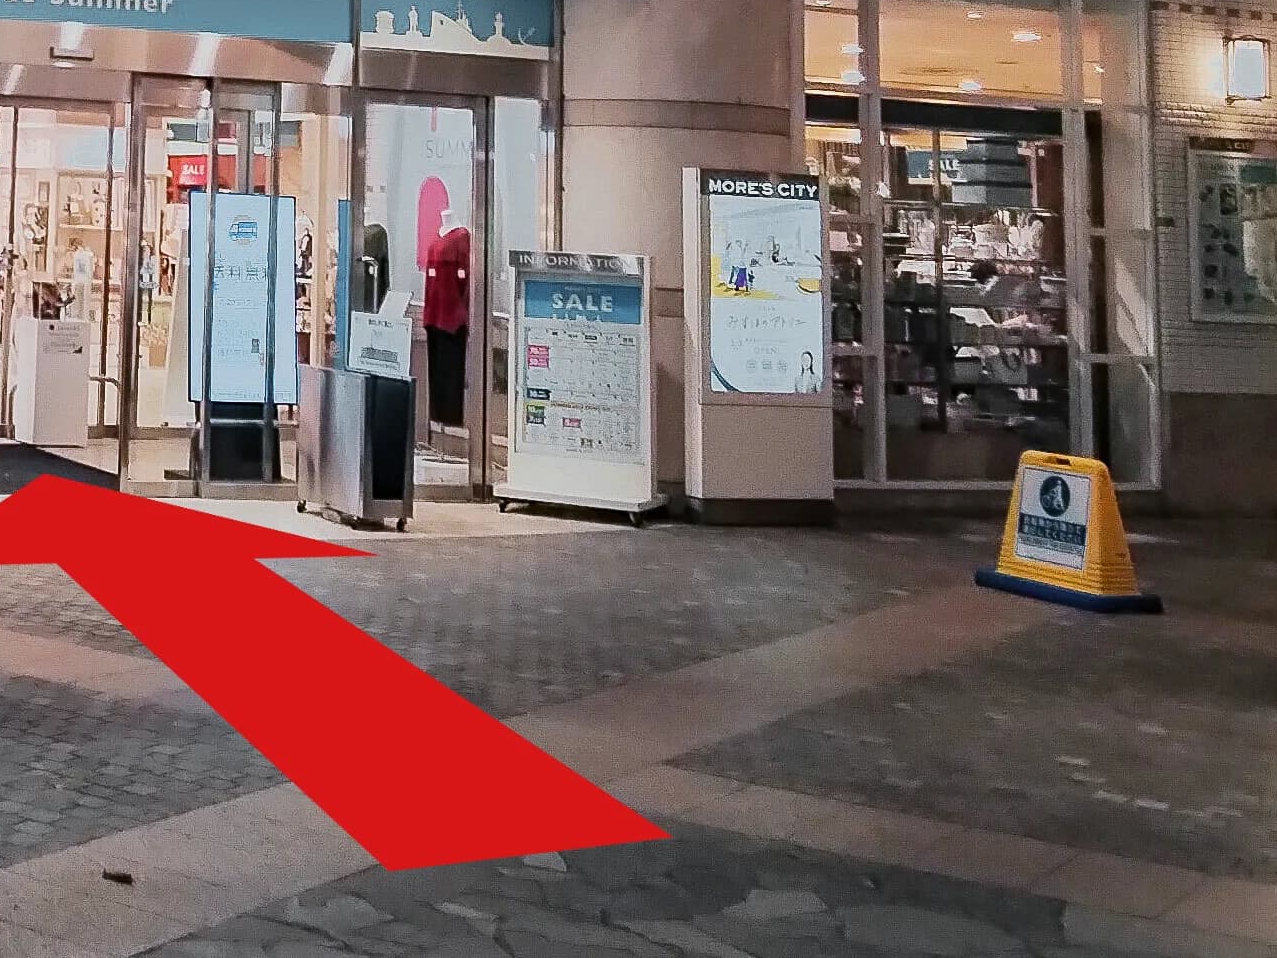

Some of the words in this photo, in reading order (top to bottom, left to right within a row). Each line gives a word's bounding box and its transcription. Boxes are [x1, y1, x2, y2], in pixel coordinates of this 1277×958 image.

[182, 164, 205, 175] SALE
[709, 178, 774, 196] MORE'S
[777, 183, 818, 198] CITY
[519, 254, 633, 270] INORMATION
[551, 293, 613, 313] SALE
